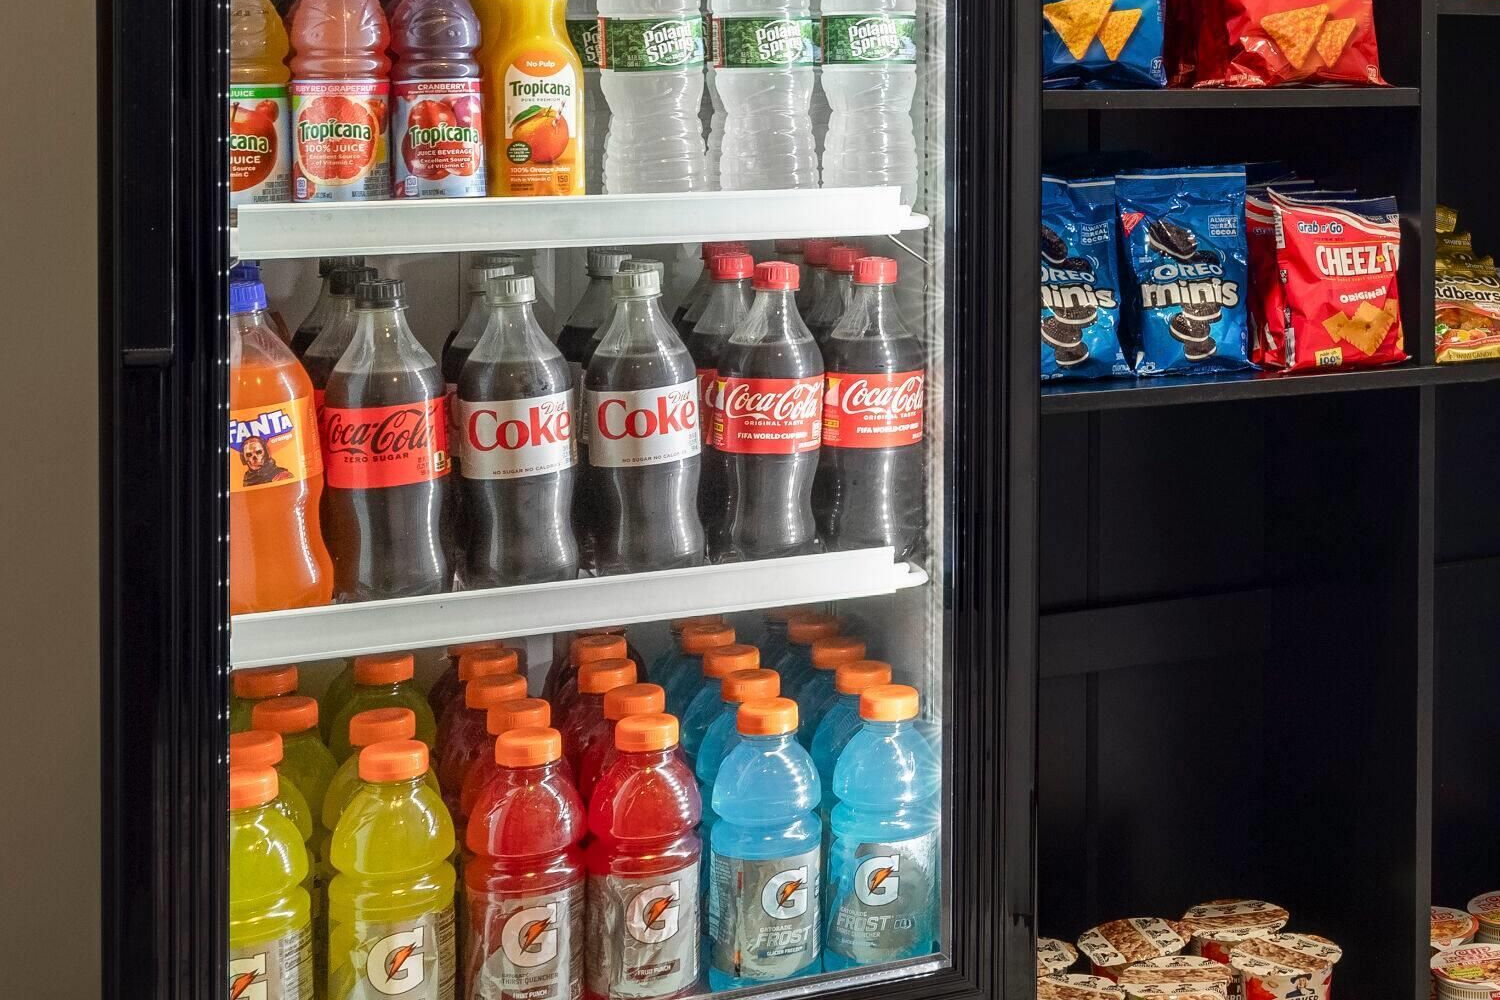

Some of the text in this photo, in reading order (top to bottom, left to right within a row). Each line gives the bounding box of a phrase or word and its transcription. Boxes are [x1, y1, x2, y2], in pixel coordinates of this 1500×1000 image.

[644, 24, 691, 44] Poland
[756, 22, 801, 43] Poland
[848, 19, 896, 39] Poland
[647, 39, 694, 63] Spring
[759, 37, 803, 60] Spring
[850, 36, 900, 59] Spring
[327, 84, 377, 92] GRAPEFRUIT
[418, 83, 466, 91] CRANBERRY
[509, 80, 571, 98] Tropicana
[300, 118, 371, 141] Tropicana
[409, 123, 479, 147] Tropicana
[305, 144, 365, 153] 100% JUICE
[1298, 222, 1343, 234] Grab Go
[1153, 263, 1223, 280] OREO
[1141, 279, 1239, 308] minis
[542, 400, 567, 415] Diet
[668, 390, 690, 403] Diet
[726, 382, 823, 421] Coca-Cola
[230, 410, 293, 443] FANTA
[469, 407, 572, 452] Coke
[598, 397, 696, 441] Coke
[324, 407, 434, 455] Coca-Cola
[737, 432, 753, 440] FIFA
[754, 432, 780, 440] WORLD
[344, 452, 409, 464] ZERO SUGAR
[854, 853, 901, 906] G
[761, 865, 809, 920] G
[626, 880, 681, 945] G
[837, 915, 891, 932] FROST
[501, 903, 559, 968] G
[756, 928, 811, 948] FROST
[366, 926, 425, 996] G
